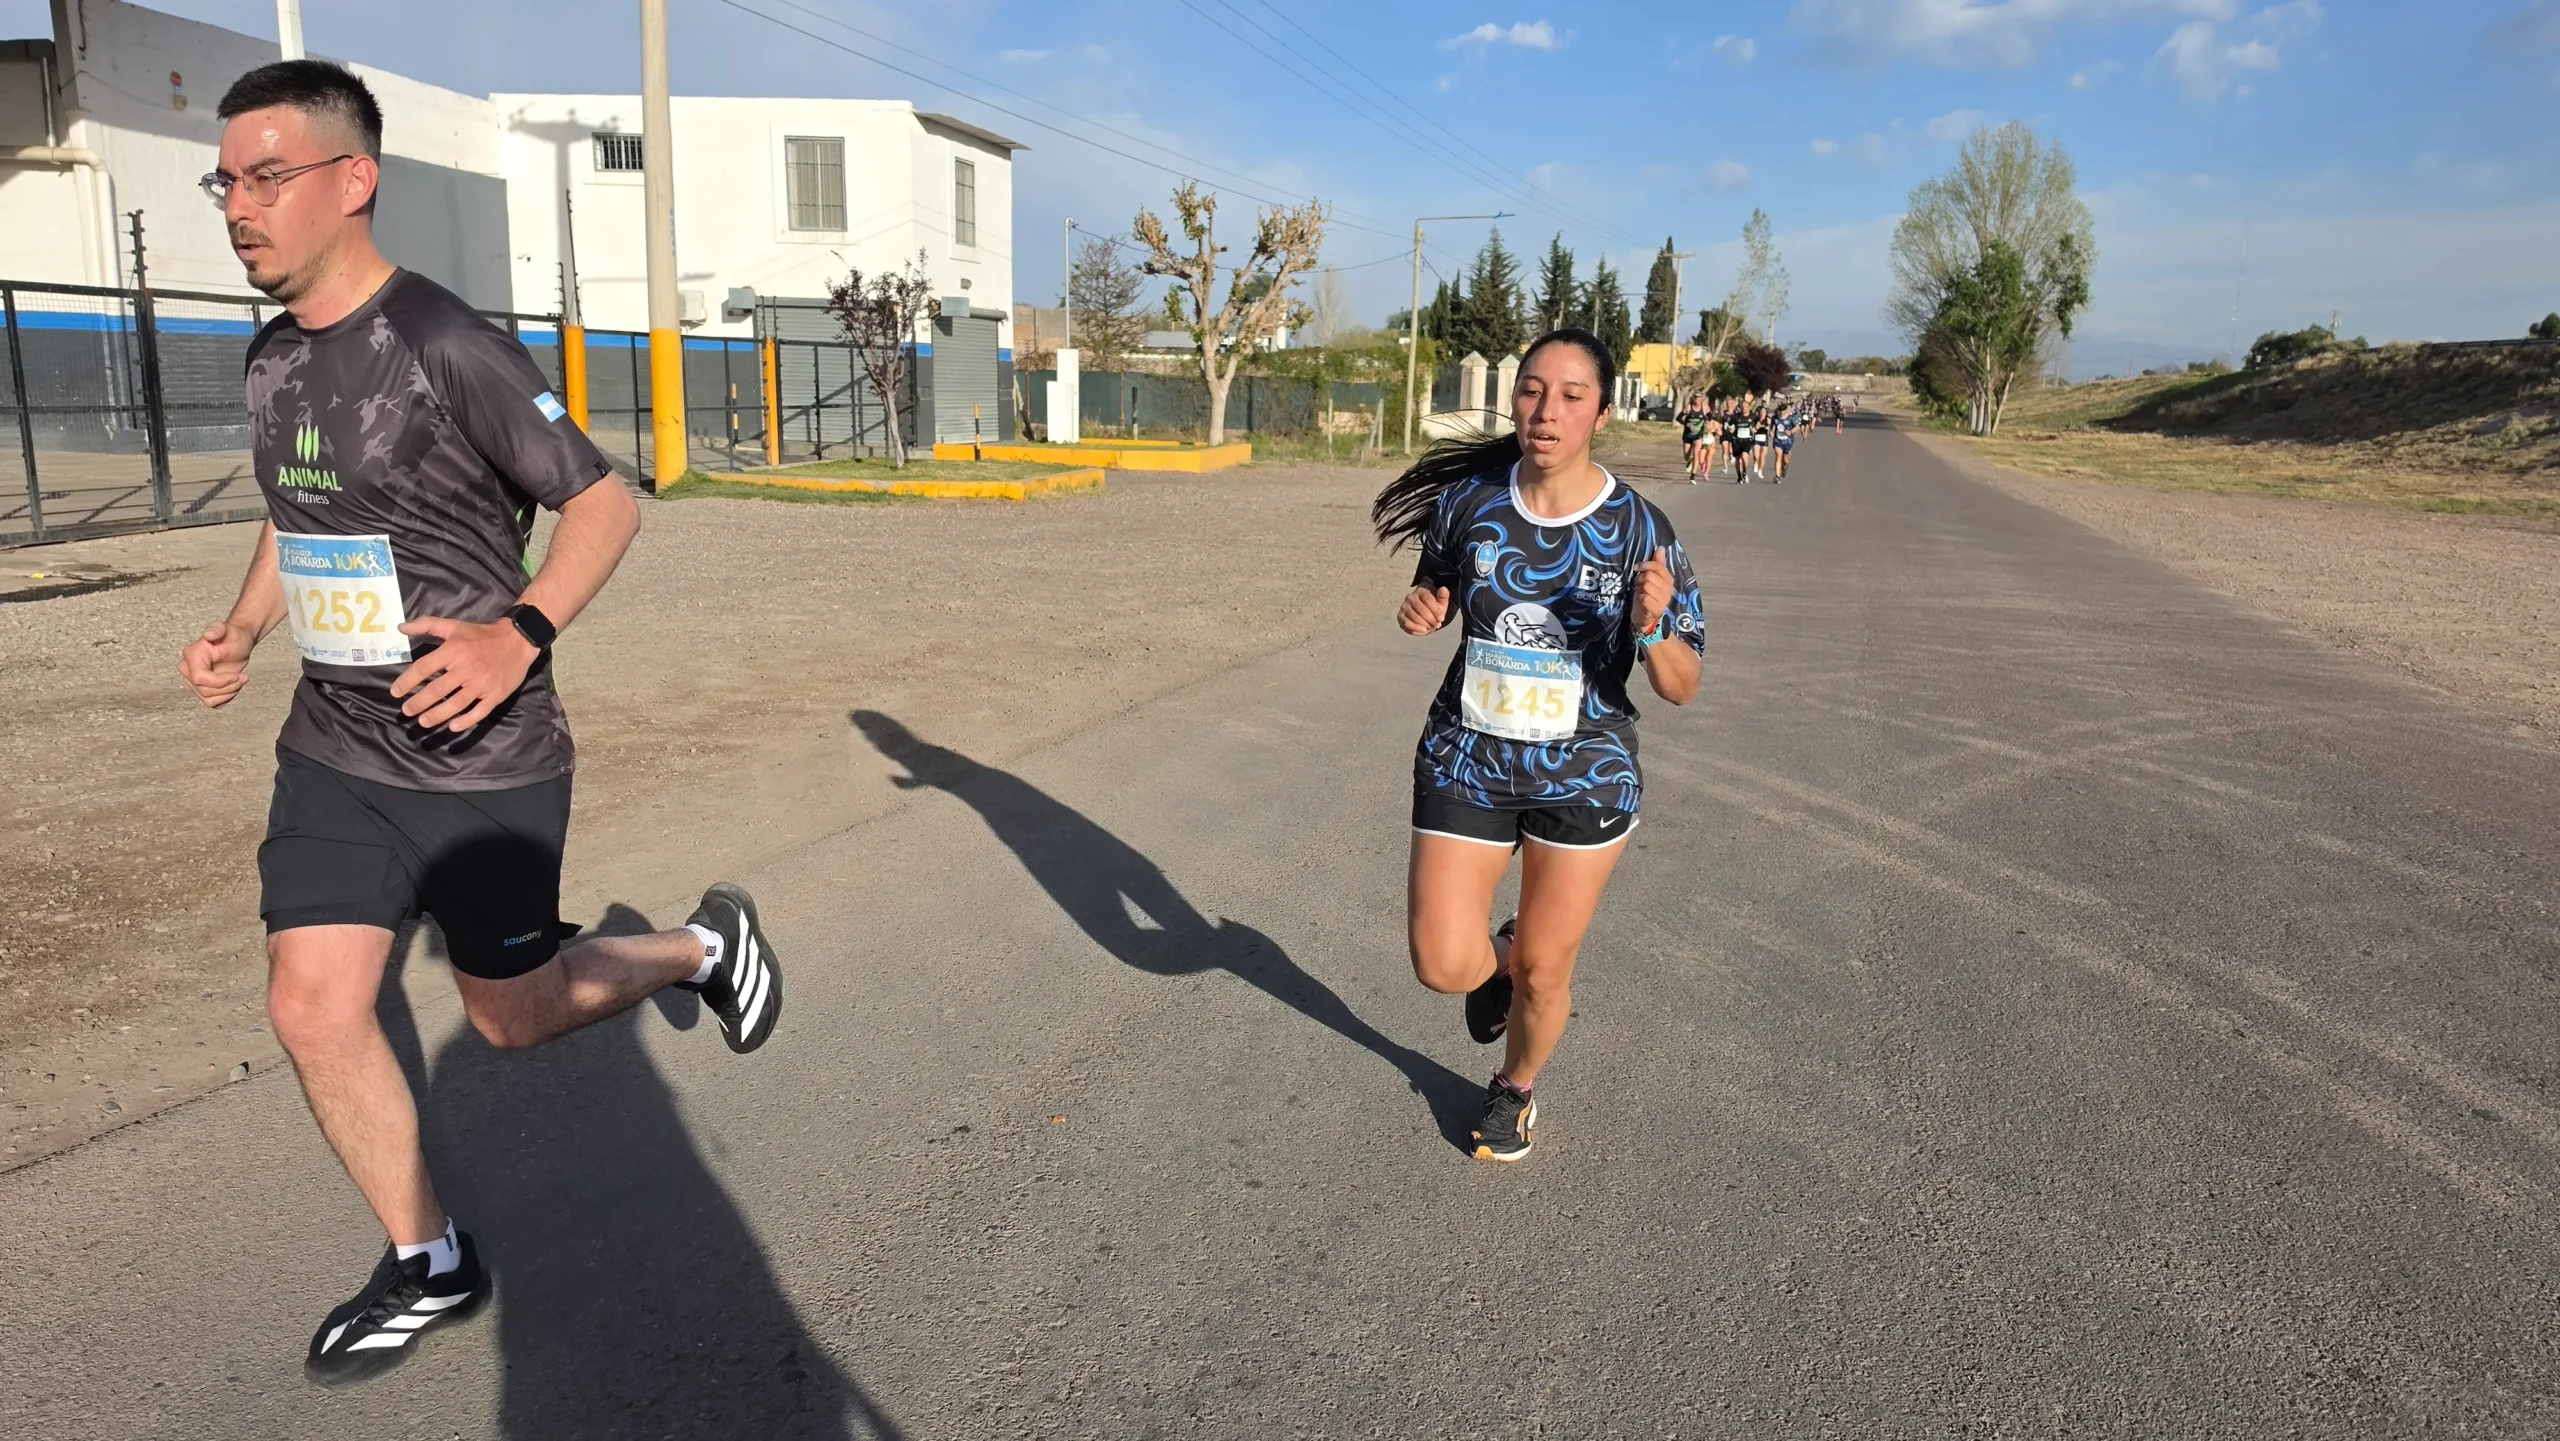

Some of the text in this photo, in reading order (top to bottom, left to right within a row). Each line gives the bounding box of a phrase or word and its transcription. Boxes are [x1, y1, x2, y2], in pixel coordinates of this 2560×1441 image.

[278, 466, 342, 491] ANIMAL
[297, 489, 329, 504] fitness
[291, 552, 367, 571] BONARDA 10K
[292, 586, 385, 634] 1252
[1485, 657, 1563, 673] BONARDA 10K
[1477, 679, 1565, 719] 1245
[503, 930, 542, 947] saucony
